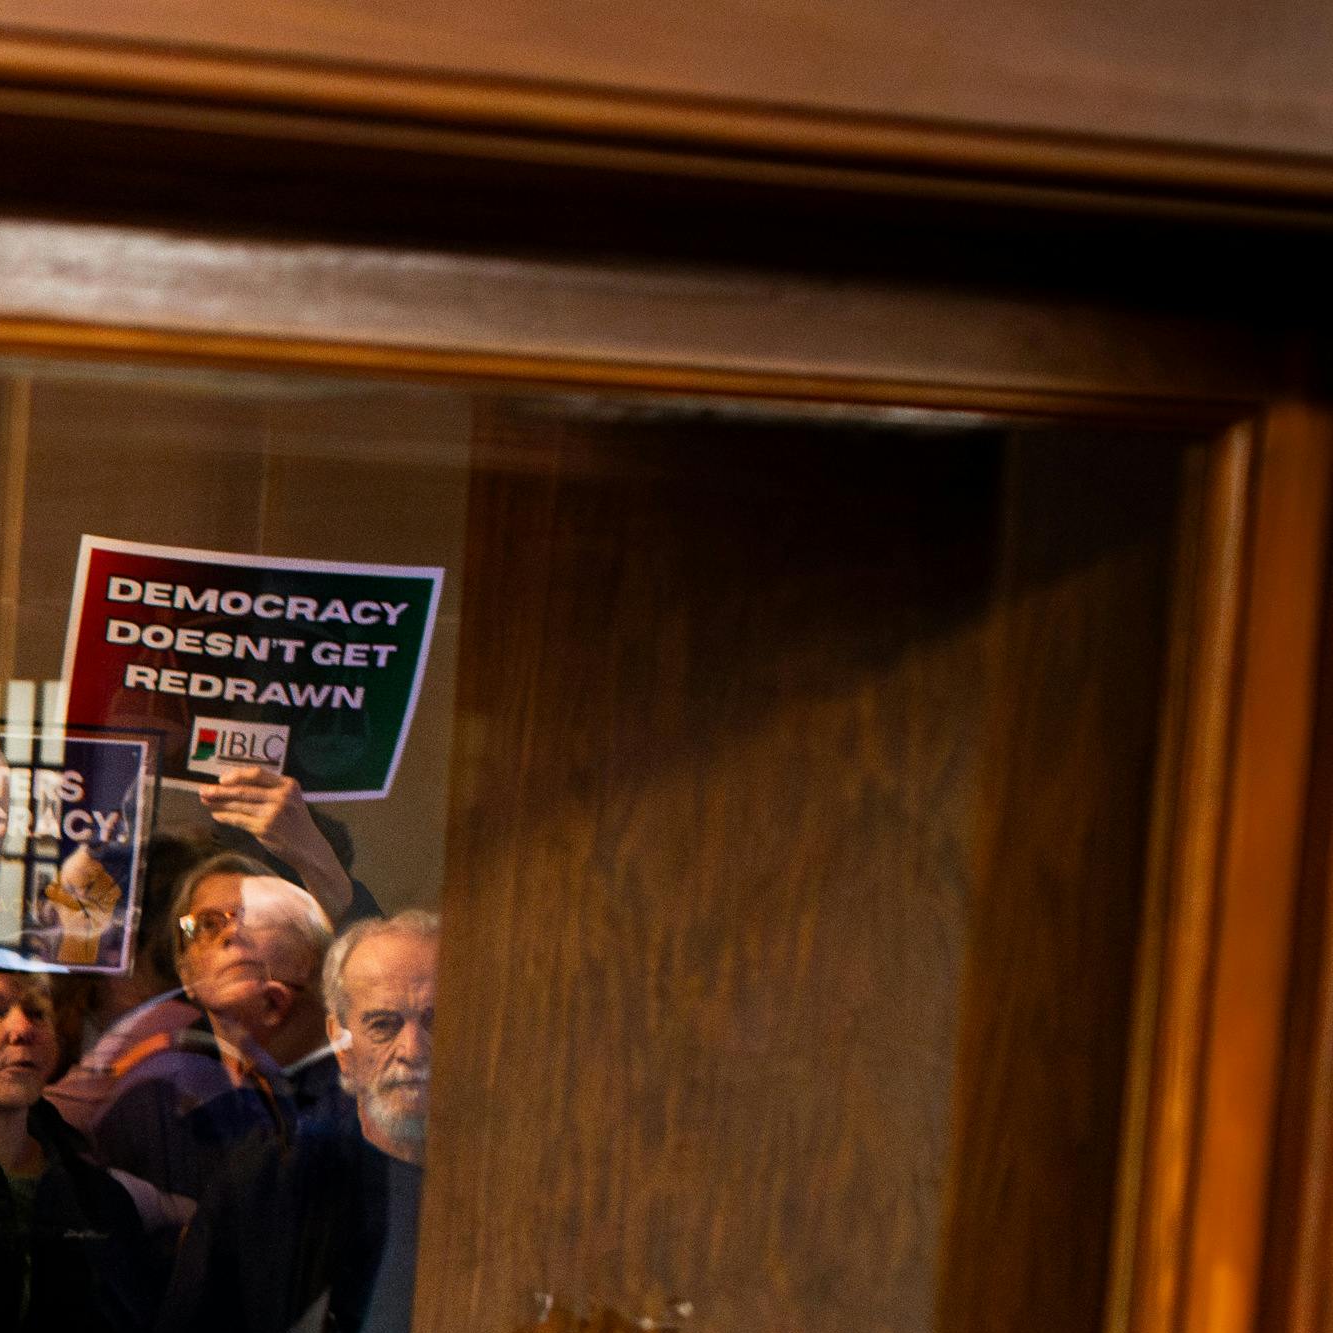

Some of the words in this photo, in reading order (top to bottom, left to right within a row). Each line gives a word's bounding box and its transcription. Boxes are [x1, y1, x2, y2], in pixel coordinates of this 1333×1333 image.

[106, 574, 410, 627] DEMOCRACY
[105, 618, 306, 666] DOESN'T
[311, 642, 398, 669] GET
[123, 662, 366, 711] REDRAWN
